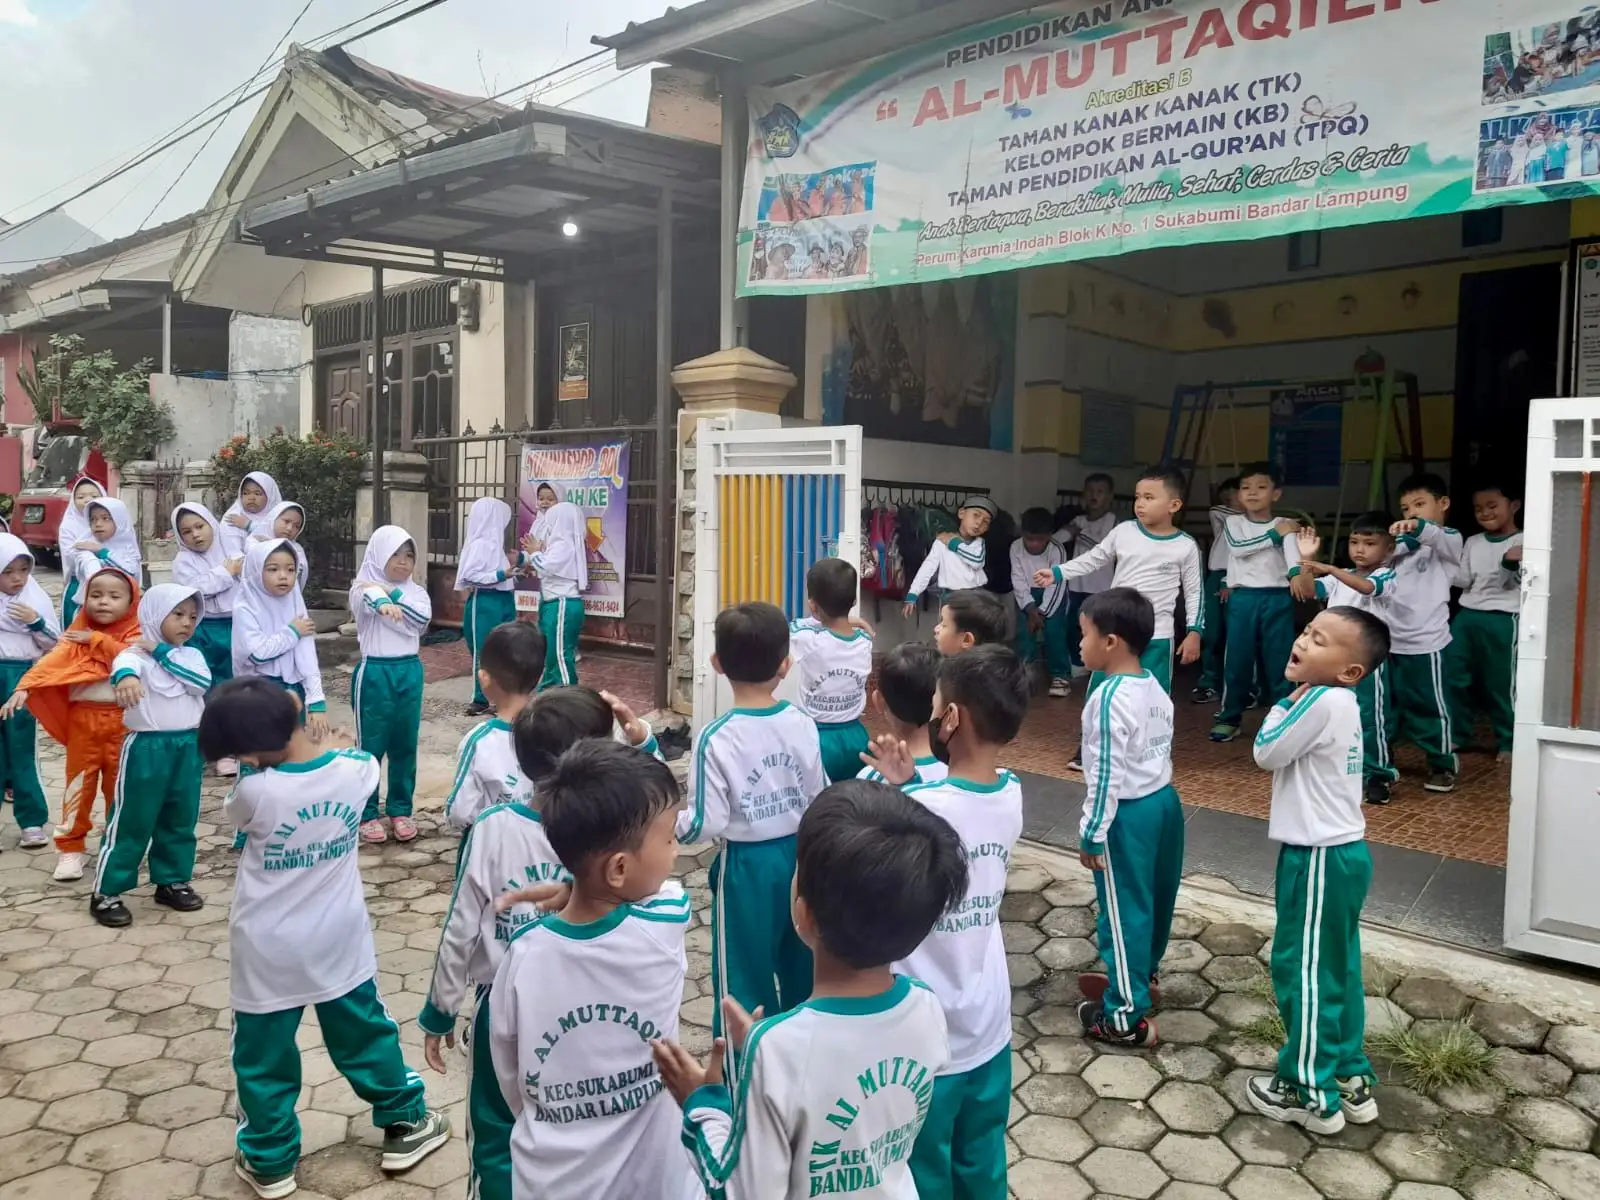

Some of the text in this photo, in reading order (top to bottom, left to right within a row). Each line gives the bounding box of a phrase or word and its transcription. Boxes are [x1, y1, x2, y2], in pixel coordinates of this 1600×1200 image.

[946, 3, 1112, 68] PENDIDIKAN
[998, 71, 1302, 153] TAMAN KANAK KANAK (TK)
[1085, 68, 1192, 110] Akreditasi B
[948, 180, 1014, 207] TAMAN
[1018, 153, 1144, 194] PENDIDIKAN
[1294, 114, 1370, 147] (TPQ)
[1004, 102, 1290, 174] KELOMPOK BERMAIN (KB)
[916, 249, 957, 265] Perum
[960, 239, 1011, 262] Karunia
[1015, 234, 1053, 252] Indah
[1058, 226, 1091, 245] Blok
[1095, 224, 1107, 238] K
[1141, 217, 1149, 231] 1
[1154, 203, 1242, 229] Sukabumi
[1246, 196, 1309, 221] Bandar
[1315, 183, 1408, 211] Lampung
[918, 221, 957, 243] Anak
[1034, 187, 1117, 222] Berakhlak
[1118, 180, 1174, 209] Mulia,
[1177, 167, 1244, 198] Sehat,
[1246, 156, 1318, 189] Cerdas
[1346, 142, 1411, 173] Ceria
[588, 488, 607, 506] KE
[263, 852, 314, 871] BANDAR
[274, 822, 297, 840] AL
[534, 1031, 559, 1065] AL
[533, 1099, 599, 1125] BANDAR
[808, 1139, 842, 1174] TK
[825, 1096, 860, 1132] AL
